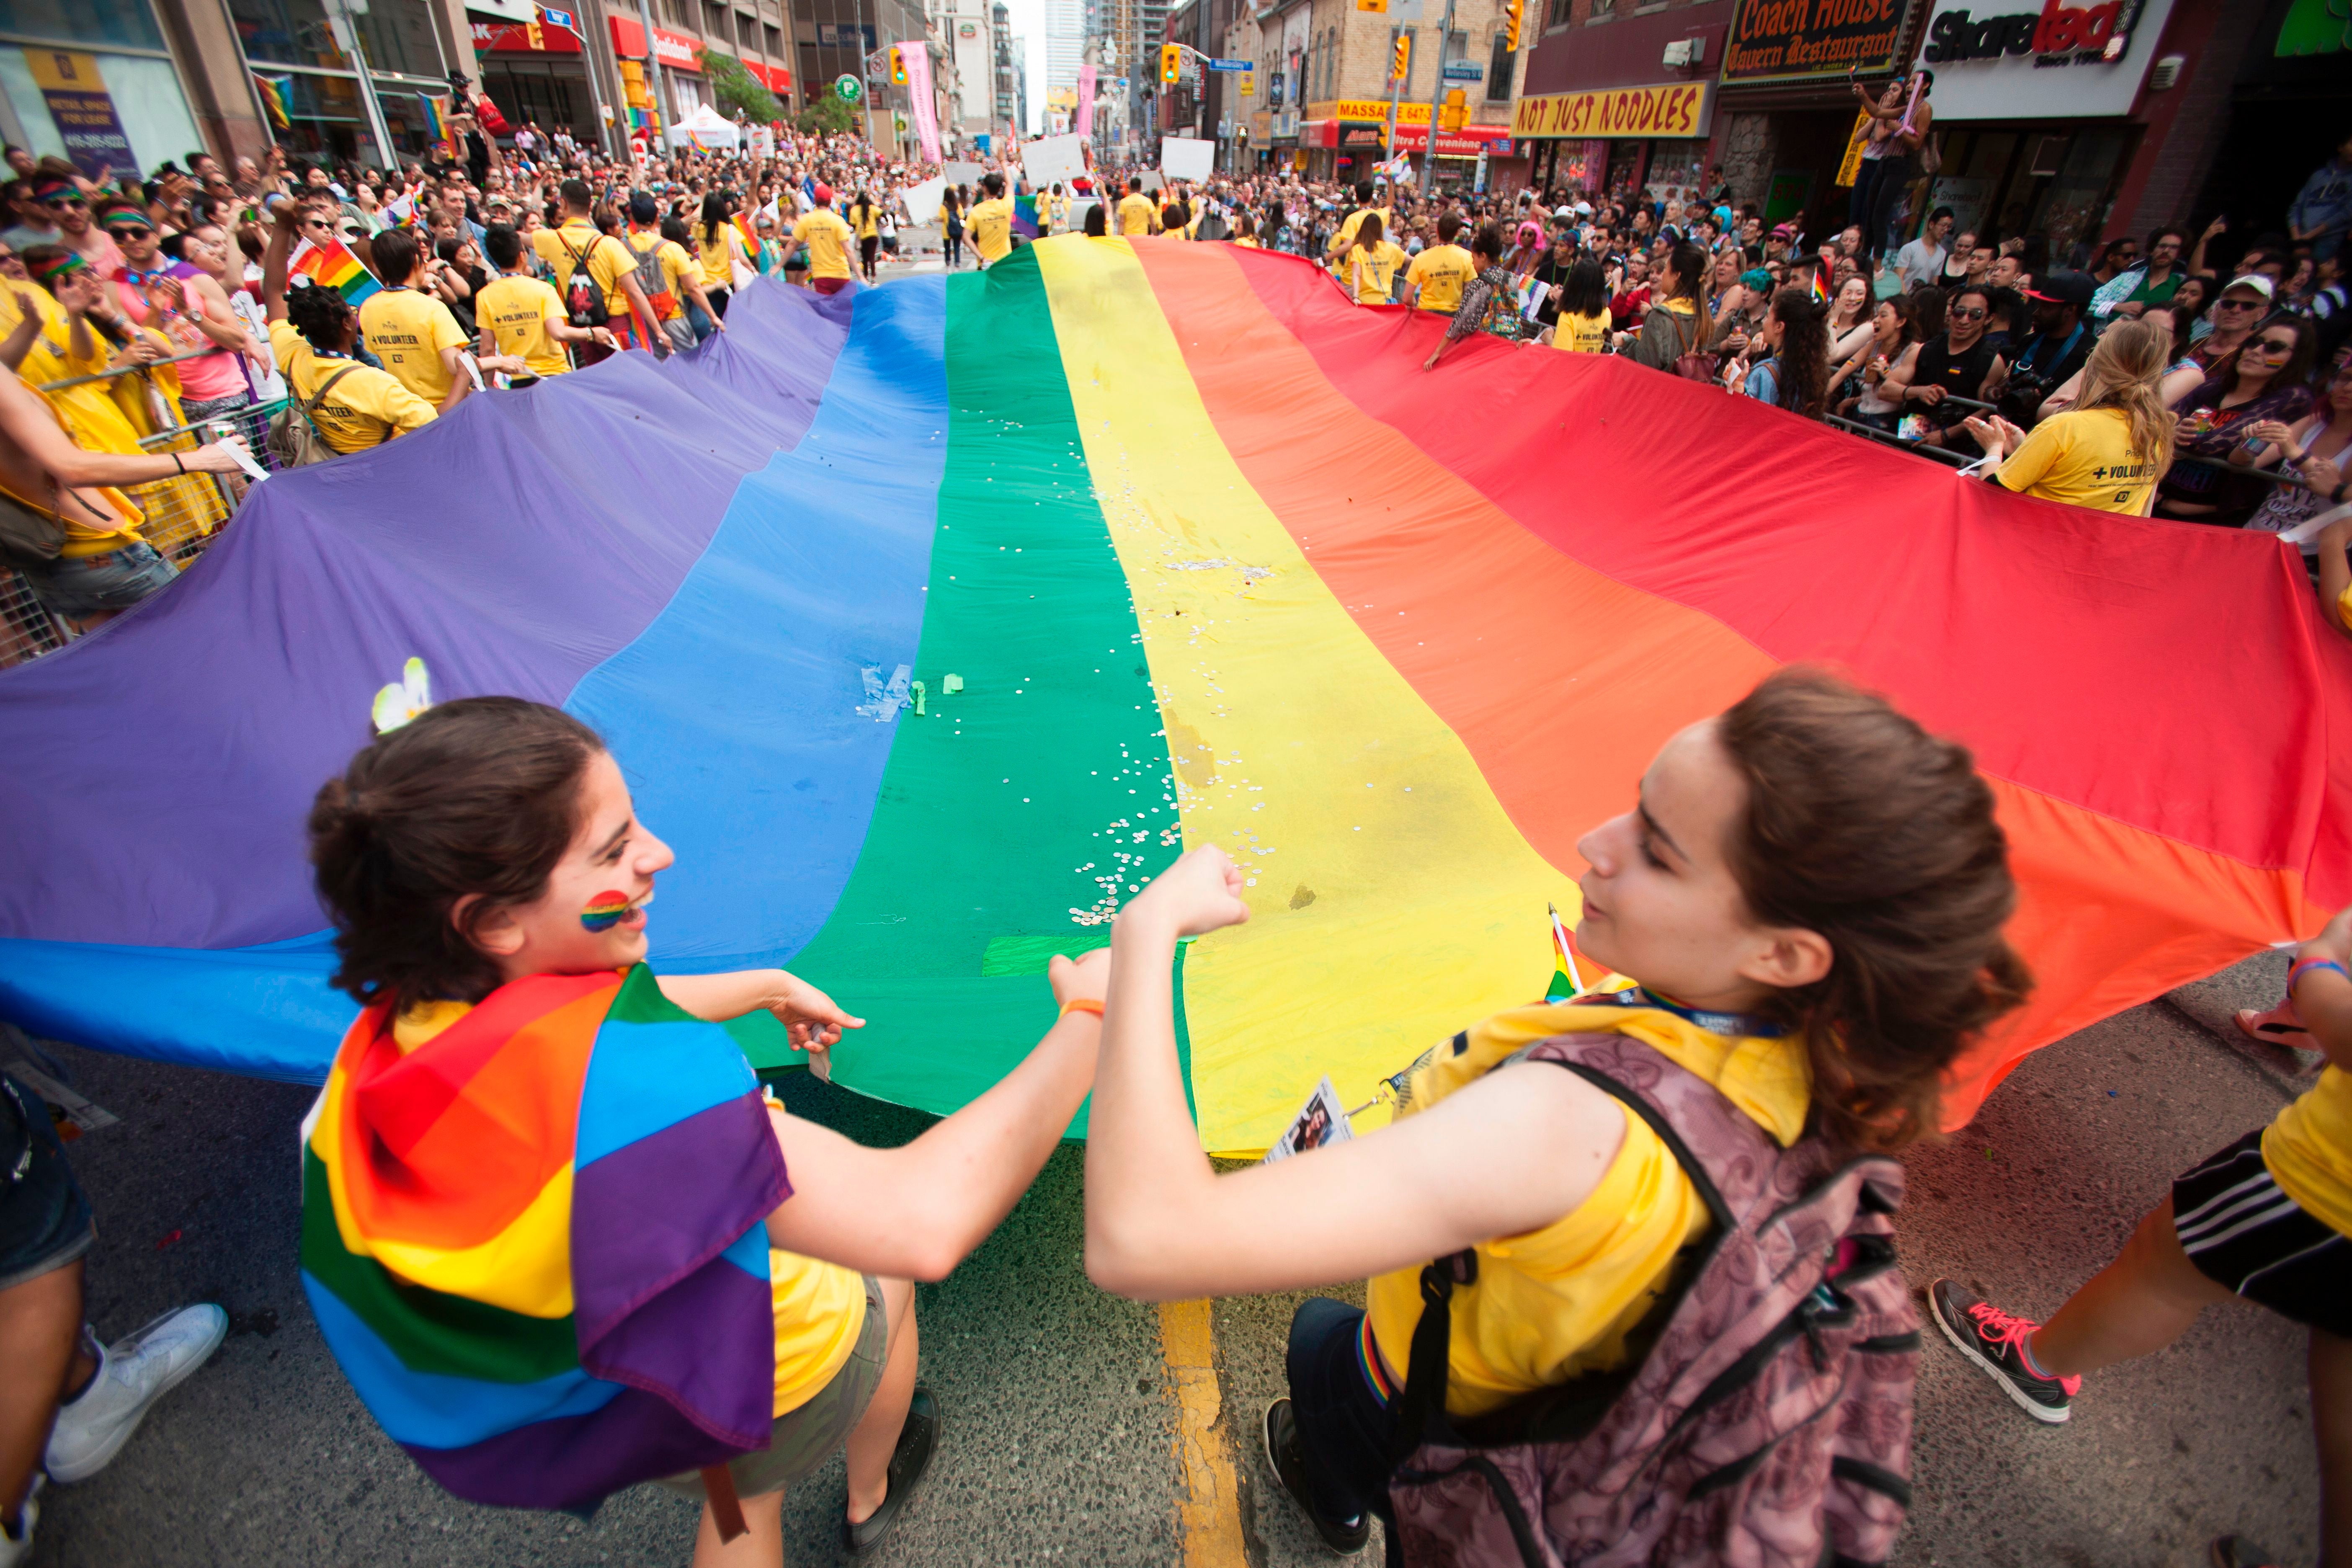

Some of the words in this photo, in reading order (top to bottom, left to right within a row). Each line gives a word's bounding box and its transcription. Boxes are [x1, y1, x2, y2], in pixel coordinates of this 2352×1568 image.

[1740, 0, 1808, 41] Coach
[1813, 0, 1895, 31] House
[652, 34, 693, 62] Scotiabank
[1728, 43, 1783, 71] Tavern
[1785, 25, 1898, 65] Restaurant
[1216, 59, 1244, 70] Wellesley
[1446, 69, 1470, 79] Wellesley
[843, 81, 855, 95] P
[1340, 103, 1403, 118] MASSAE
[1517, 99, 1547, 133] NOT
[1553, 95, 1595, 133] JUST
[1599, 86, 1697, 132] NOODLES
[1345, 129, 1378, 142] Mars
[1394, 134, 1415, 147] ltra
[503, 311, 538, 321] VOLUNTEER
[379, 335, 418, 345] VOLUNTEER
